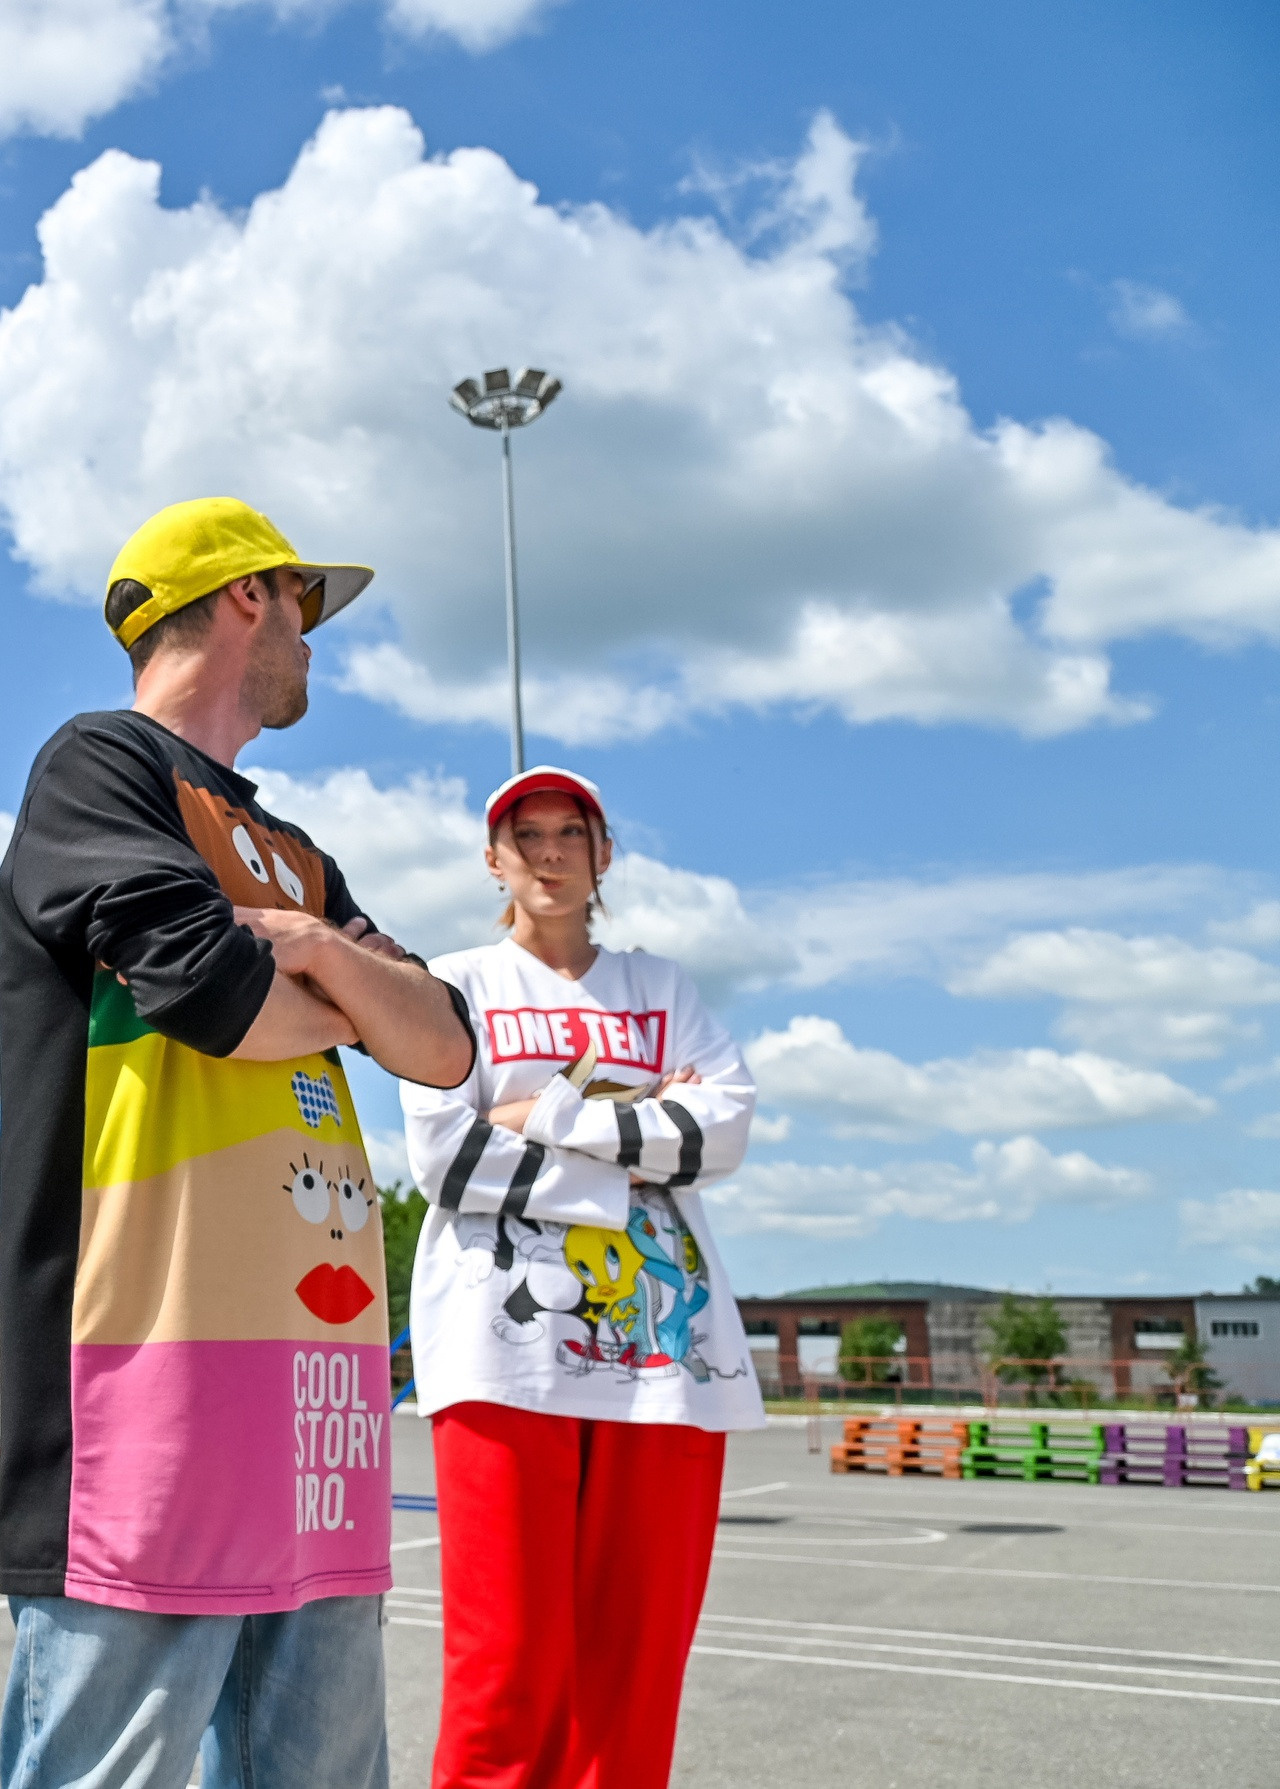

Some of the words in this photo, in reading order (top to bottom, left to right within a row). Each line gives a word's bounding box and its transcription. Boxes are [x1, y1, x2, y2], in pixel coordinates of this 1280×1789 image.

[491, 1011, 576, 1058] ONE
[293, 1351, 368, 1411] COOL
[294, 1410, 384, 1470] STORY
[295, 1472, 355, 1535] BRO.
